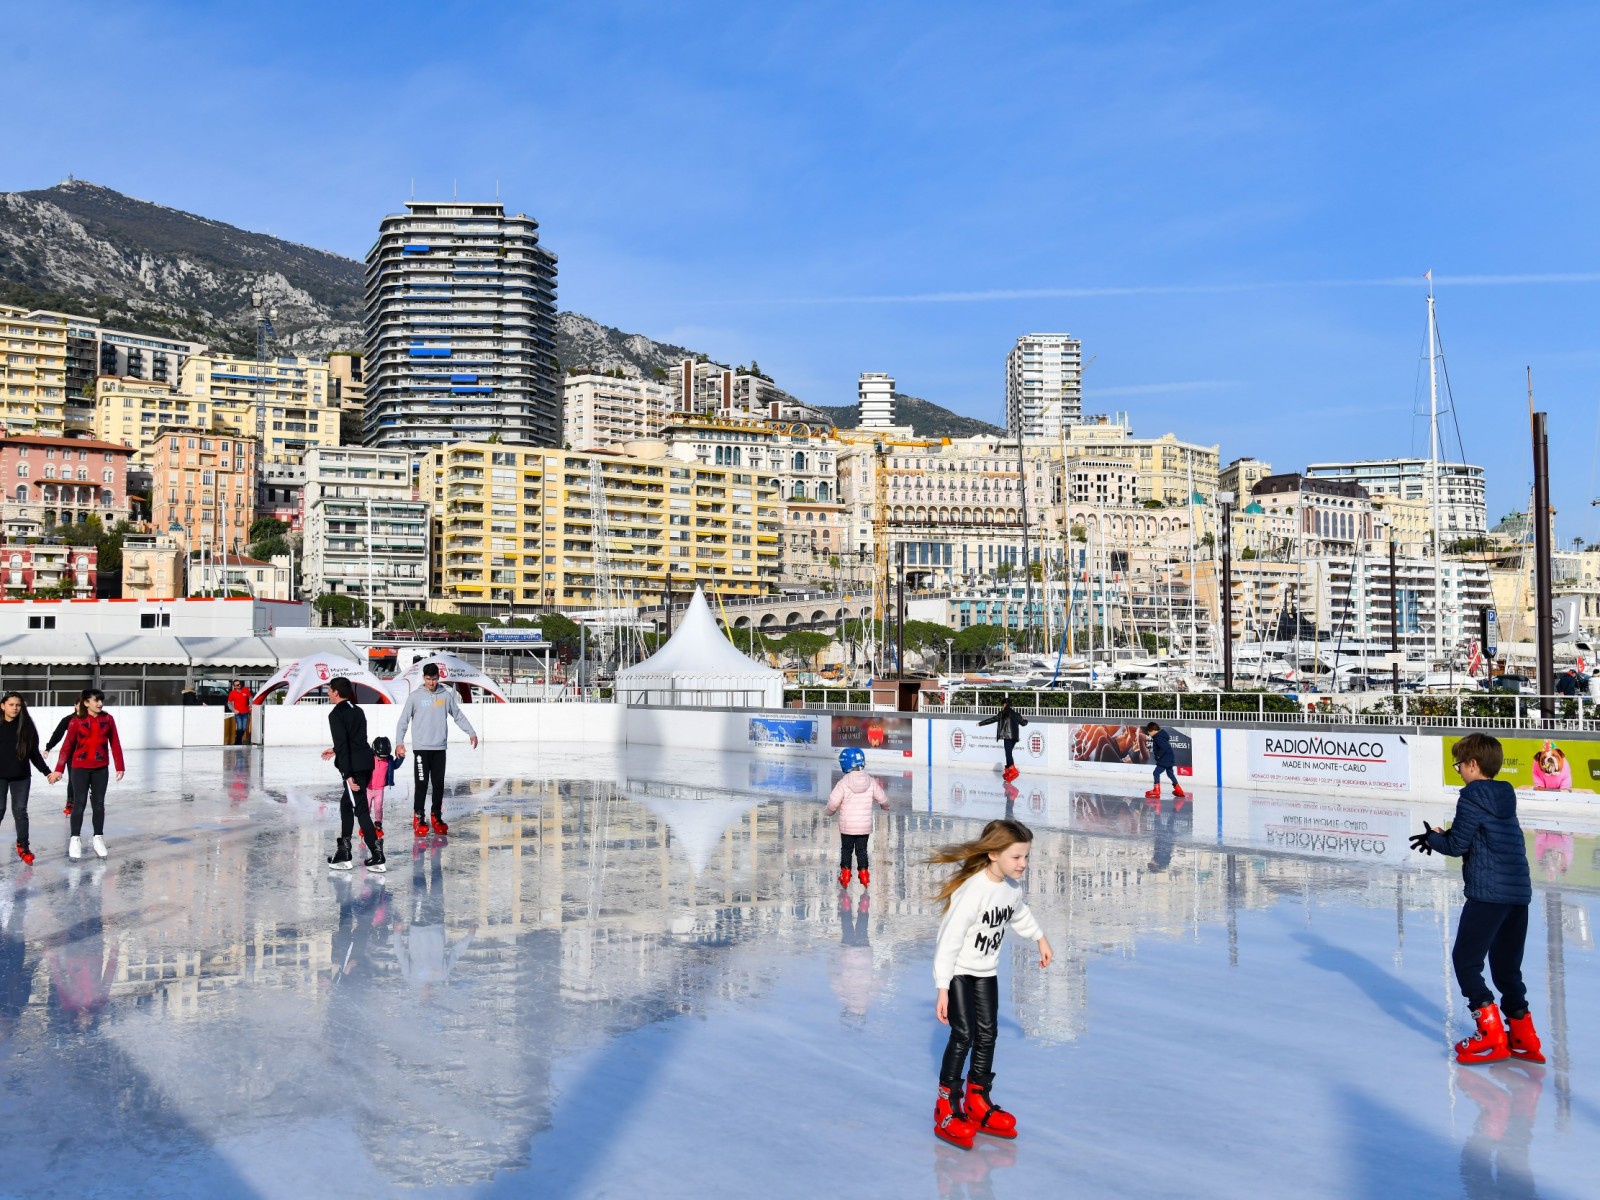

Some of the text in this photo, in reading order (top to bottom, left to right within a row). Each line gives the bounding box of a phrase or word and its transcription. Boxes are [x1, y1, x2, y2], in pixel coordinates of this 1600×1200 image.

[1265, 737, 1384, 758] RADIOMONACO
[1282, 760, 1366, 773] MADE IN MONTE-CARLO
[982, 905, 1014, 928] ALWAY
